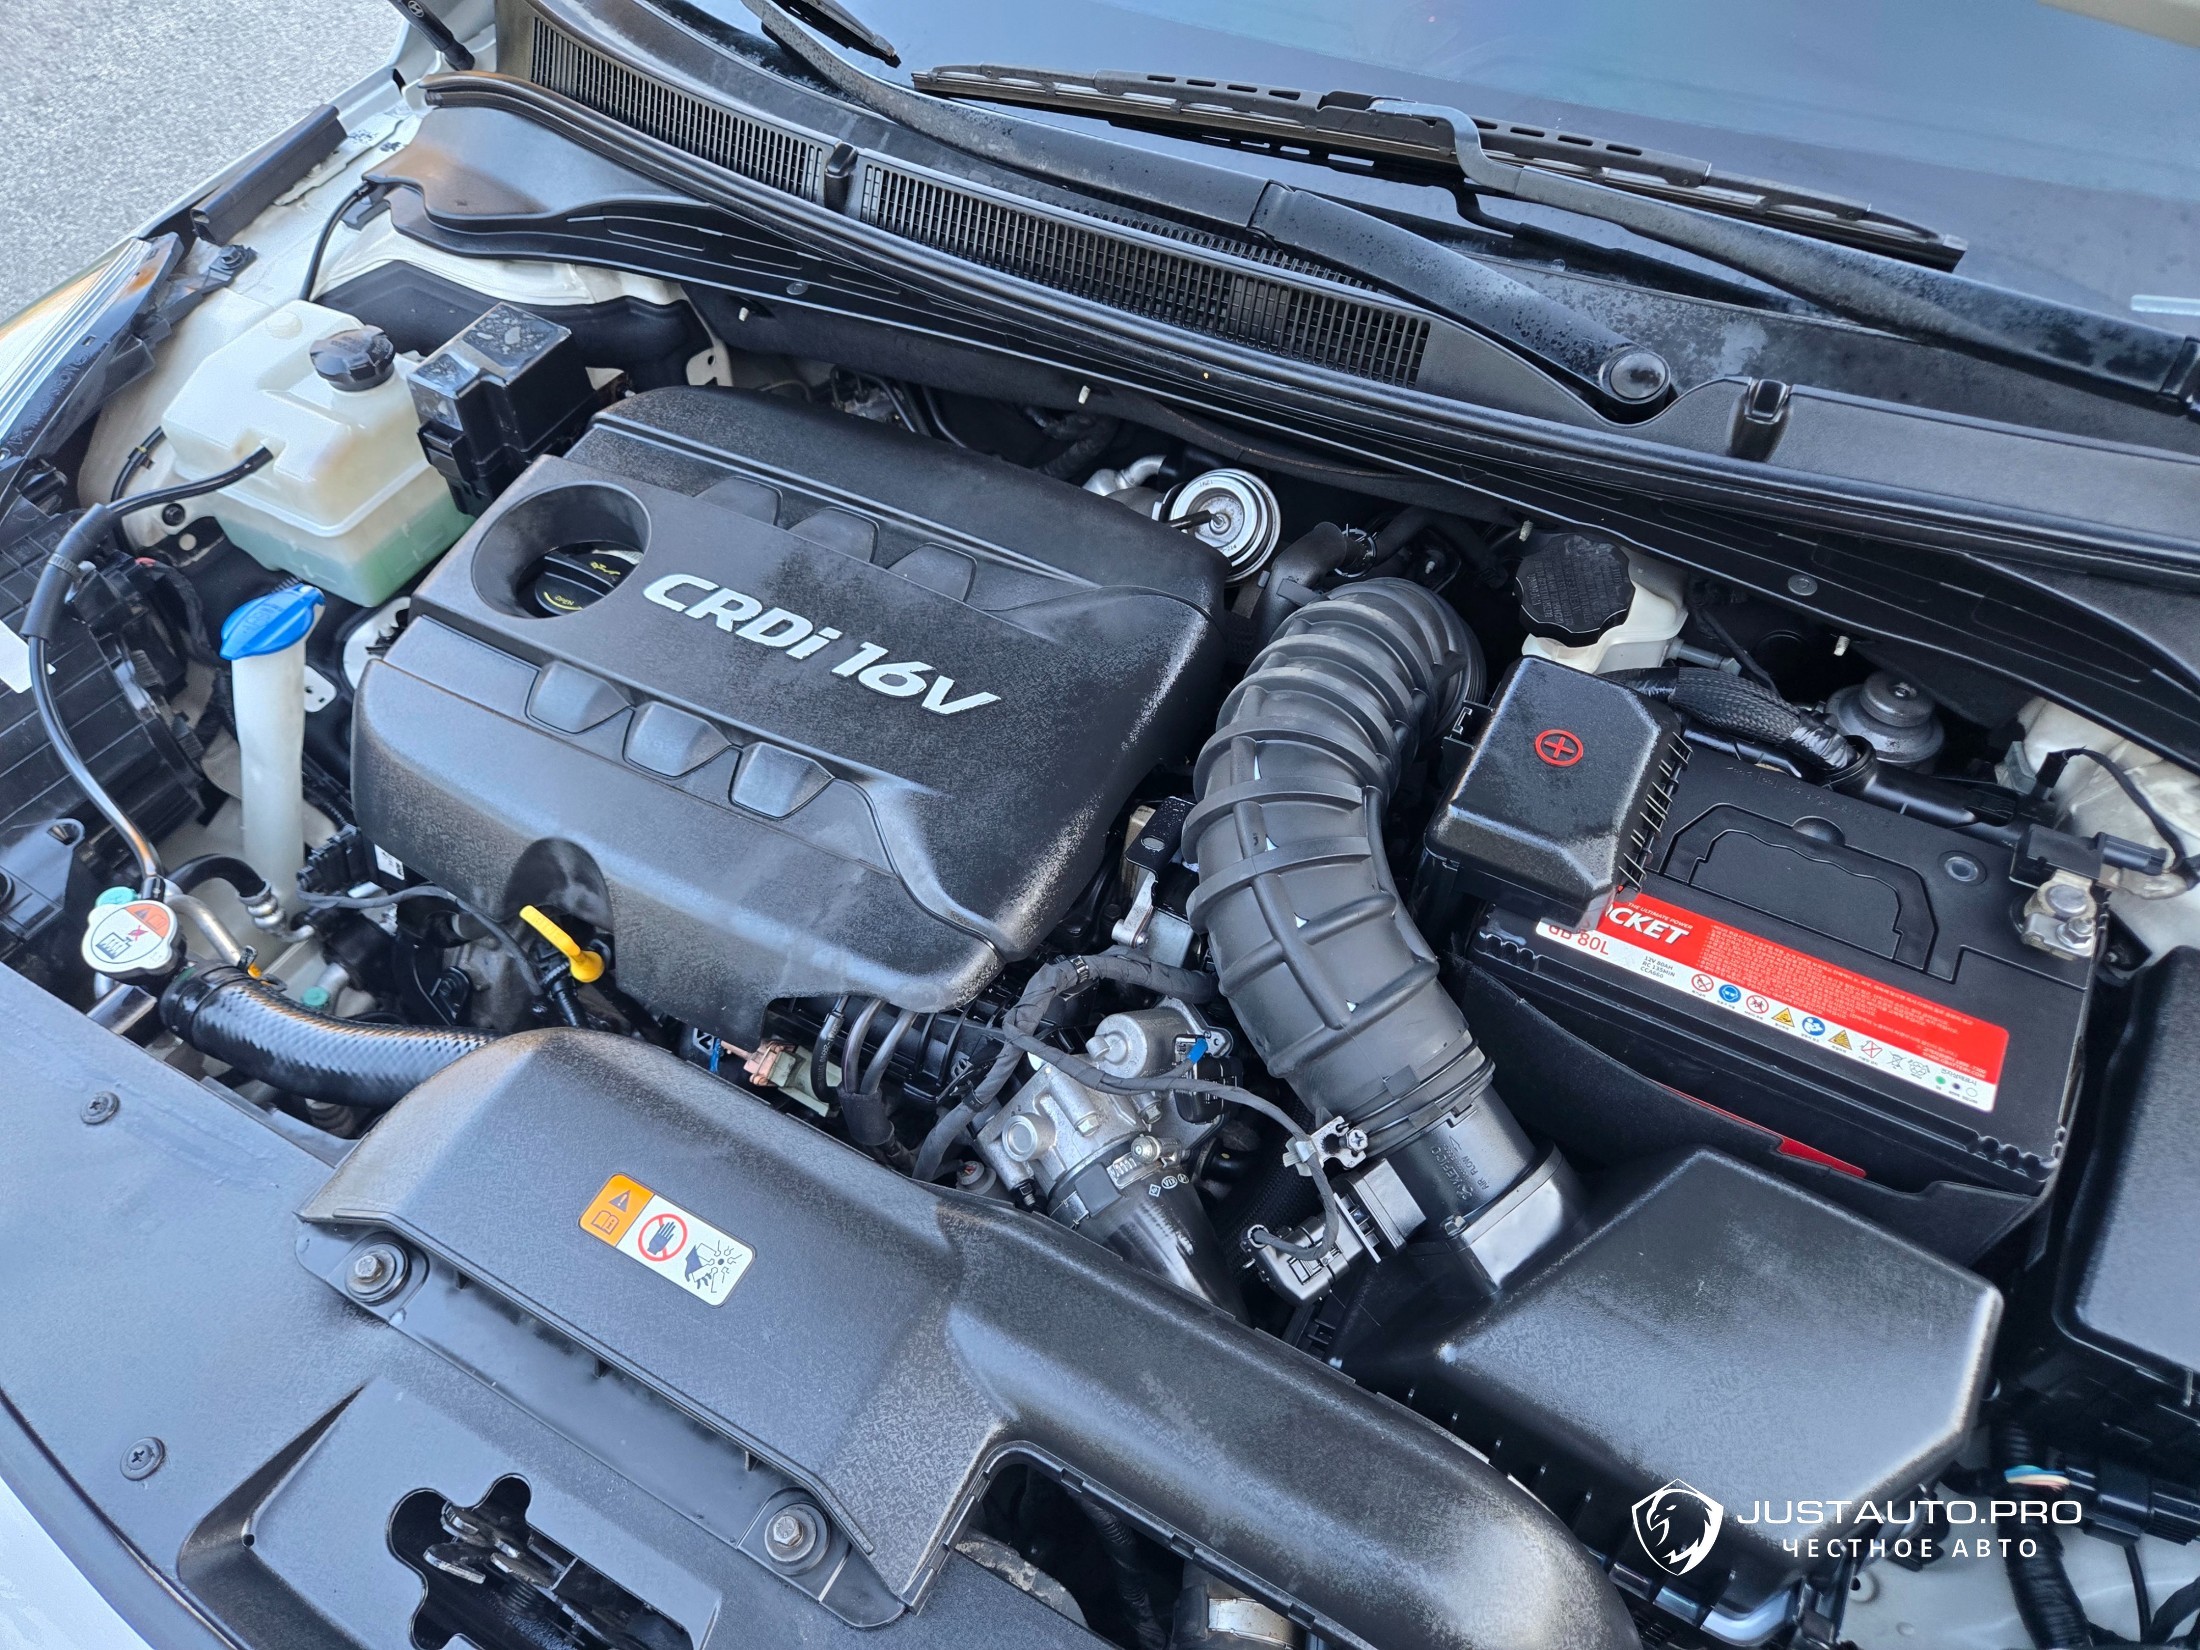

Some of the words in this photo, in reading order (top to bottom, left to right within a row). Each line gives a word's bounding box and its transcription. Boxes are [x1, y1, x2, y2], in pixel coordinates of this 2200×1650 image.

[555, 595, 575, 606] OPEN
[643, 574, 843, 660] CRDi
[831, 641, 1001, 715] 16V
[1628, 902, 1642, 911] THE
[1640, 906, 1670, 921] ULTIMATE
[1669, 917, 1694, 930] POWER
[1577, 929, 1609, 955] 80L
[1462, 1156, 1479, 1176] FLOW
[1162, 1177, 1177, 1188] KIA
[1477, 1177, 1490, 1190] AIR
